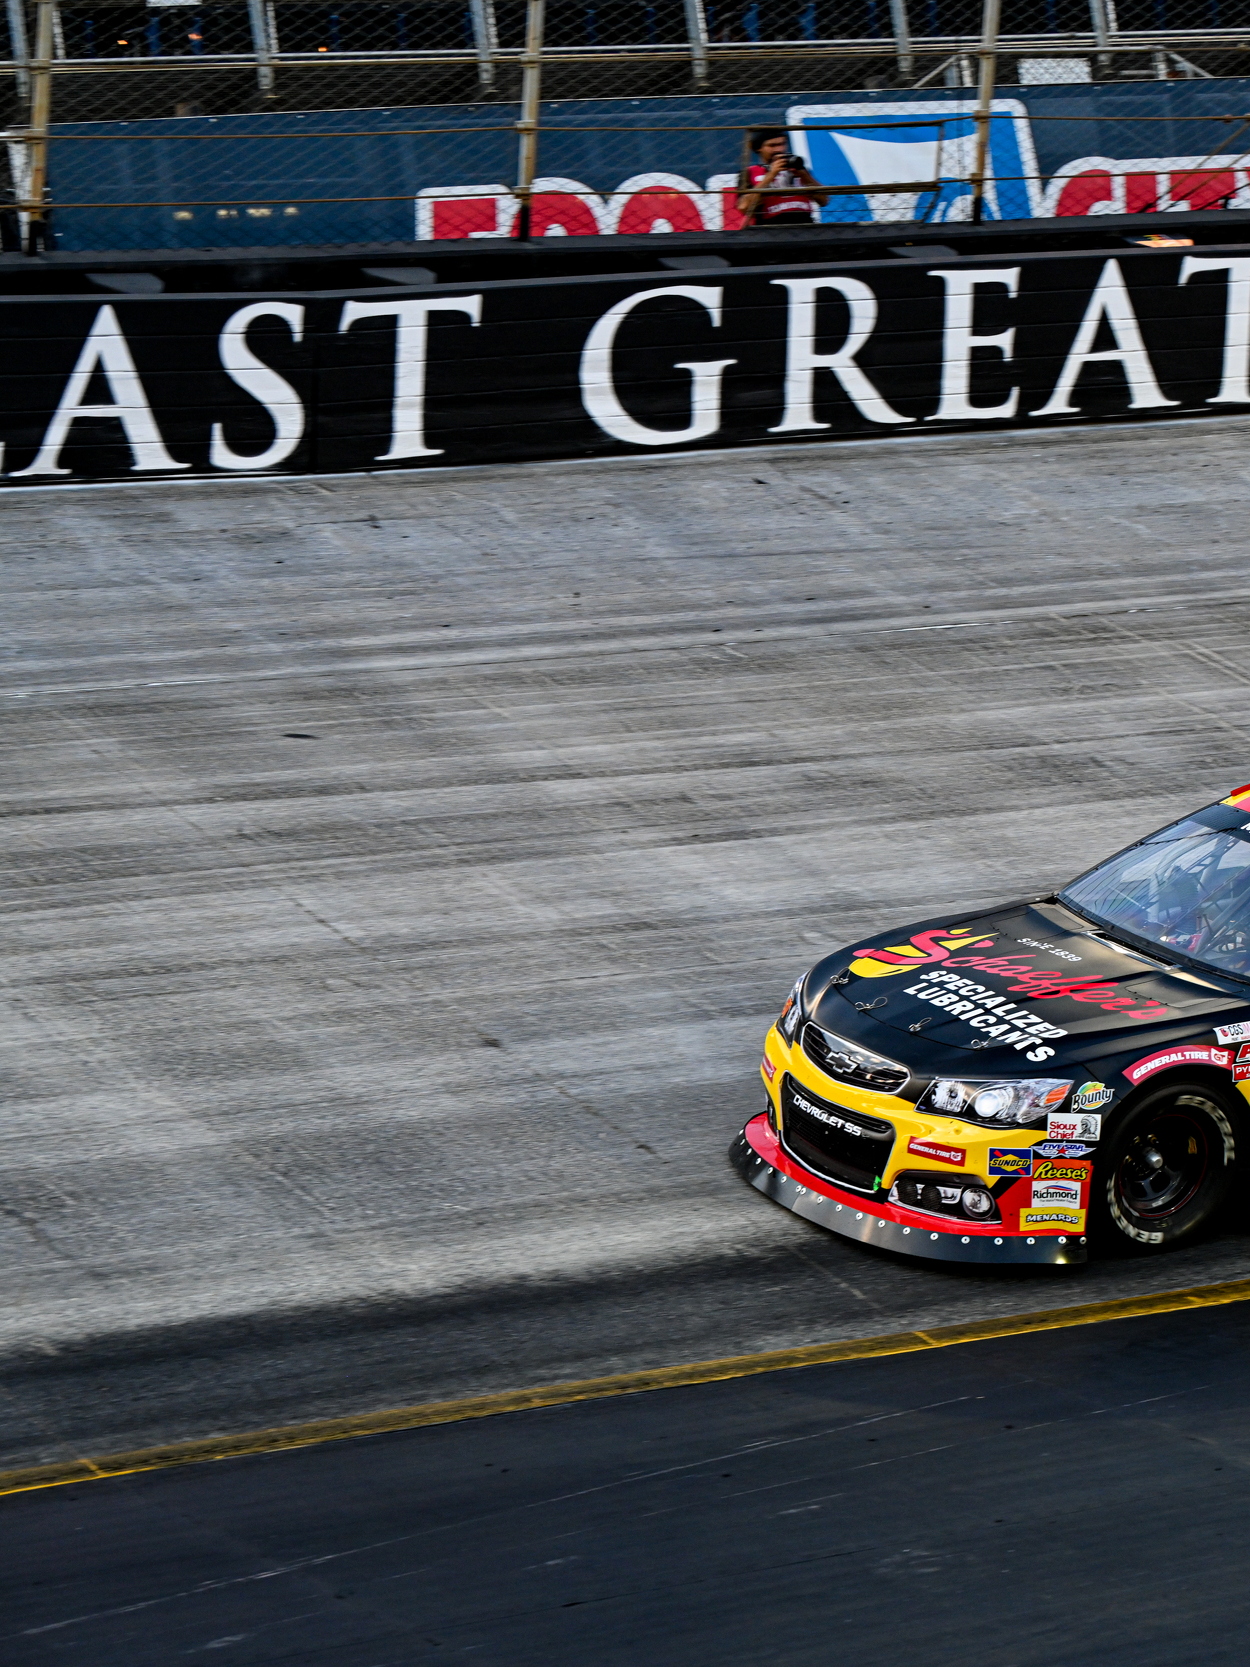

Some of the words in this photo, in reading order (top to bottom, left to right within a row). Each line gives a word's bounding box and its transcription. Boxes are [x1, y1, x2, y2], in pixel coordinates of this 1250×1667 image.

[0, 294, 483, 478] AST
[1048, 948, 1083, 962] 1839
[919, 970, 1069, 1041] SPECIALIZED
[903, 982, 1056, 1063] LUBRICANTS
[1132, 1052, 1184, 1080] GENERAL
[1184, 1051, 1210, 1060] TIRE
[1072, 1088, 1114, 1113] Bounty
[793, 1095, 846, 1129] CHEVROLET
[844, 1122, 862, 1137] SS
[1049, 1121, 1077, 1131] Sioux
[1049, 1130, 1075, 1139] Chief
[909, 1143, 938, 1155] GENERAL
[936, 1149, 952, 1158] TIRE
[1043, 1143, 1062, 1151] FIVE
[1064, 1143, 1084, 1152] STAR
[991, 1159, 1028, 1167] SUNOCO
[1033, 1161, 1089, 1180] Reese's
[1033, 1189, 1078, 1200] Richmond
[1026, 1213, 1079, 1224] MENARDS
